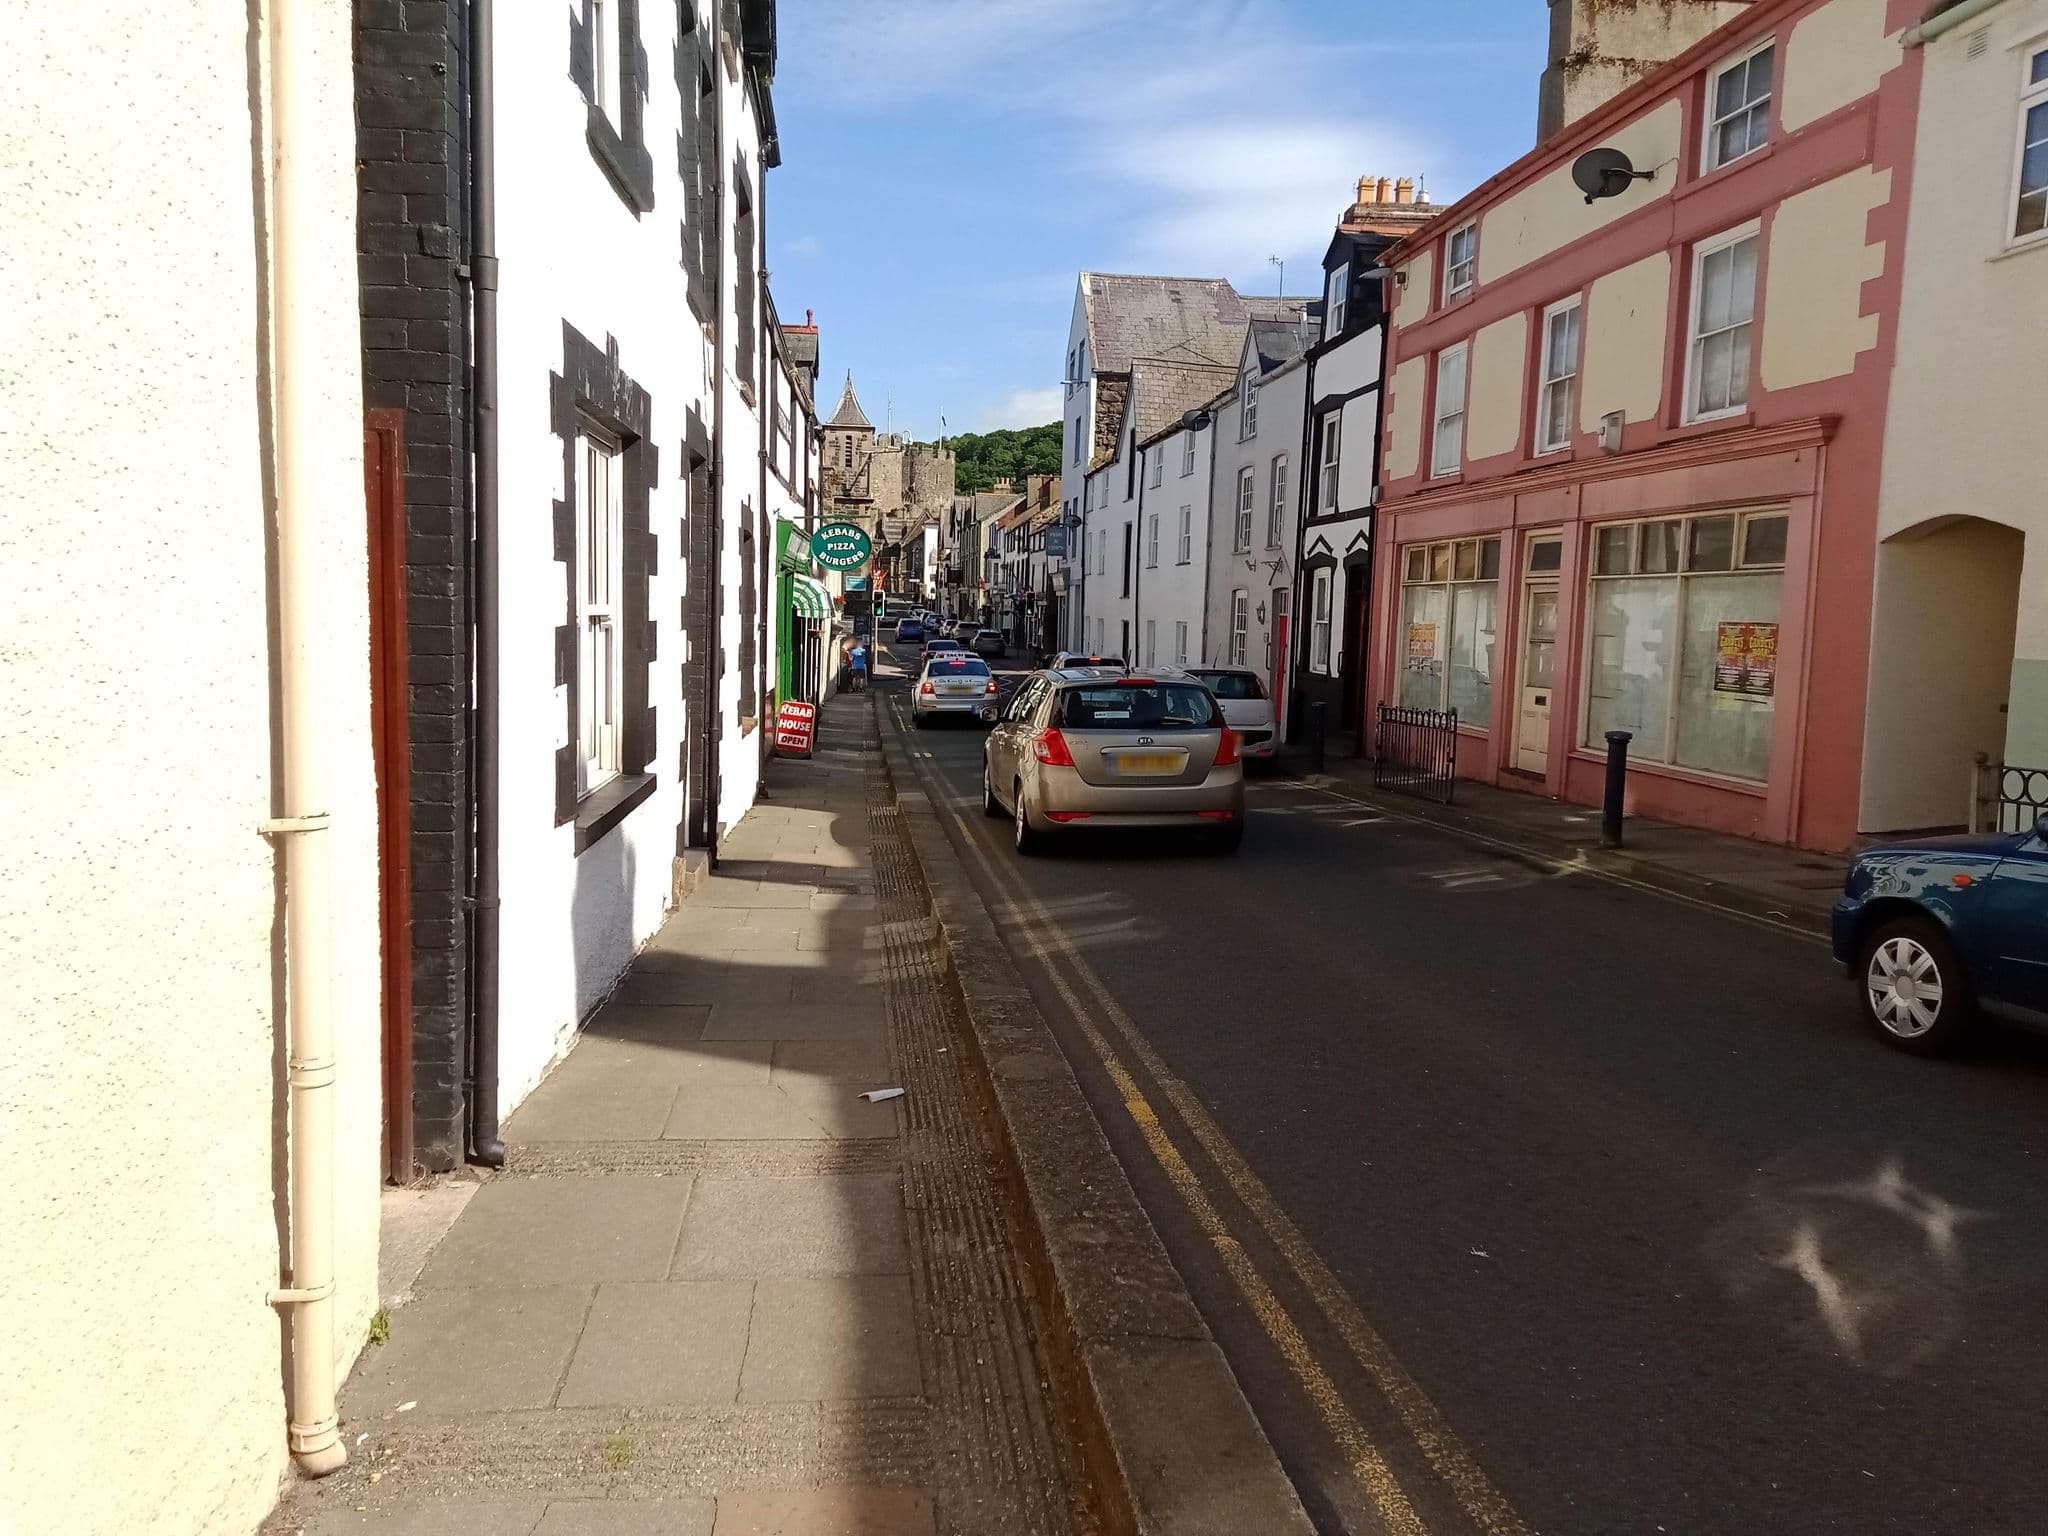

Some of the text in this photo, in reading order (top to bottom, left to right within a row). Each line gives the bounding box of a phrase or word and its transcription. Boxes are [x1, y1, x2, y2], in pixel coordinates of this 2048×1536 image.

[821, 528, 862, 541] KEBABS
[827, 542, 856, 551] PIZZA
[819, 550, 865, 566] BURGERS
[780, 703, 813, 718] KEBAB
[778, 718, 812, 732] HOUSE
[781, 735, 805, 746] OPEN
[1139, 737, 1152, 745] KIA
